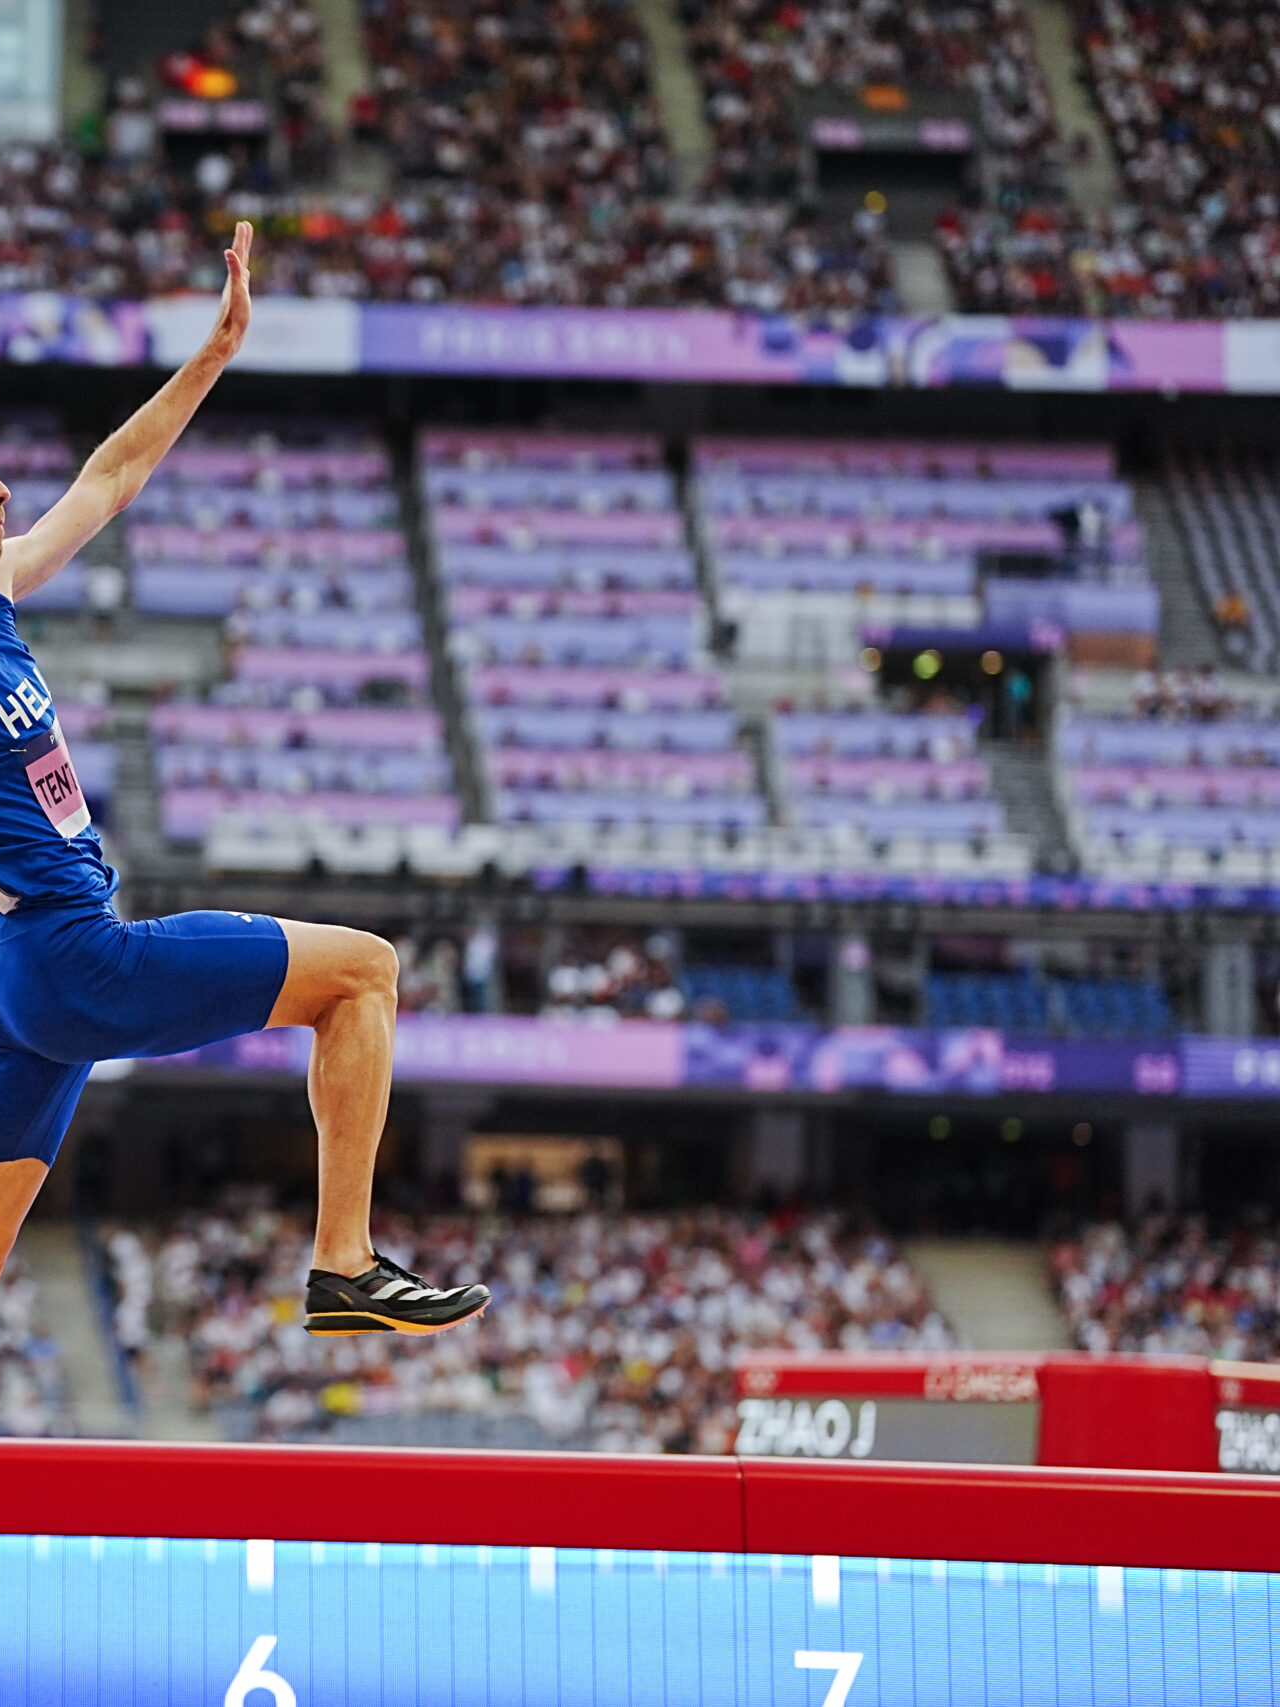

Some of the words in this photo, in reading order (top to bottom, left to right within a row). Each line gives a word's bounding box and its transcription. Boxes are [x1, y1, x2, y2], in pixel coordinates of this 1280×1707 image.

[735, 1399, 852, 1457] ZHAO
[849, 1400, 877, 1458] J
[224, 1635, 296, 1707] 6
[794, 1650, 864, 1707] 7
